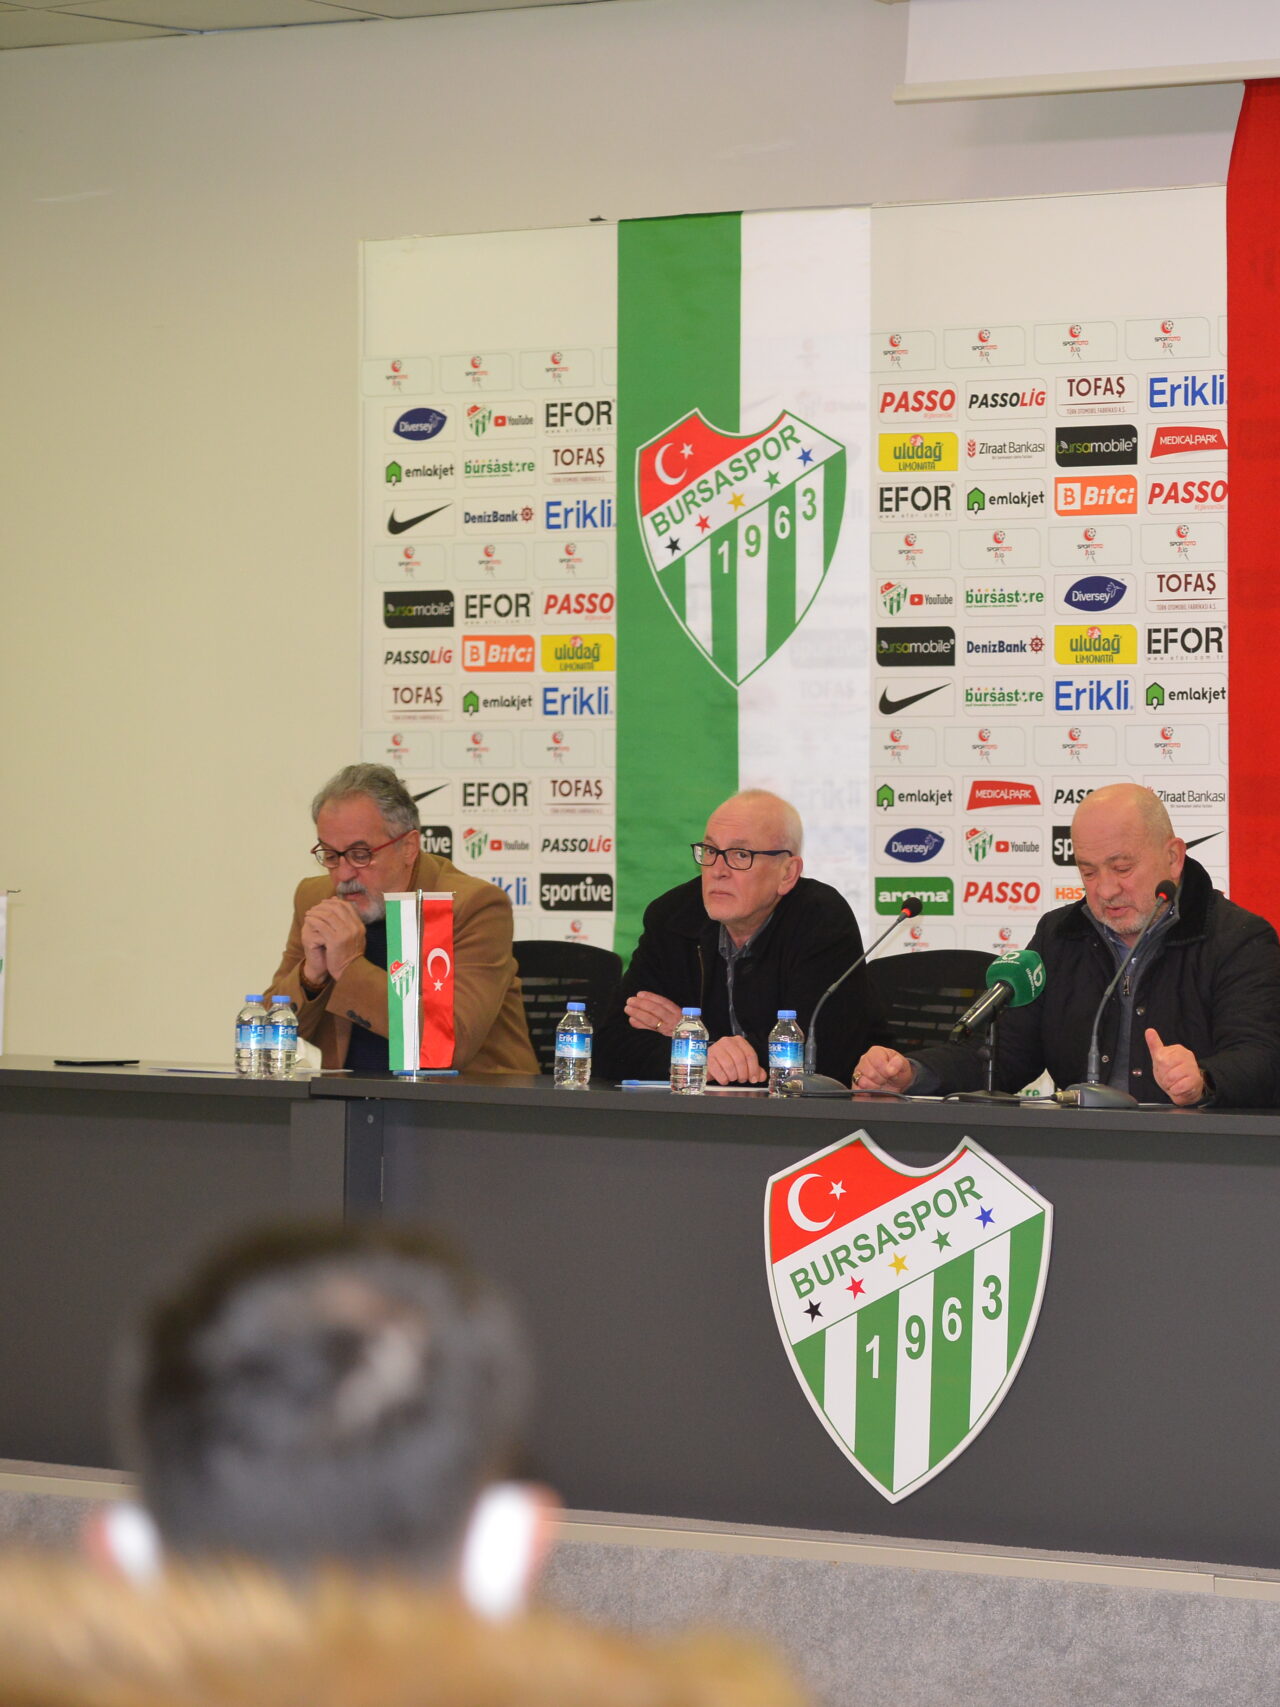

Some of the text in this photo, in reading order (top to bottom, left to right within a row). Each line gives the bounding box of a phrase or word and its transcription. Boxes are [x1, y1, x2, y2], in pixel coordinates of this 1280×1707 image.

[1067, 377, 1125, 398] TOFAŞ
[1149, 374, 1225, 408] Erikli
[880, 389, 956, 413] PASSO
[507, 415, 534, 426] YouTube
[545, 401, 613, 427] EFOR
[399, 415, 434, 434] Diversey
[553, 448, 605, 468] TOFAŞ
[893, 442, 942, 461] uludağ
[979, 442, 1045, 454] Ziraat Bankası
[405, 465, 454, 479] emlakjet
[650, 425, 801, 537] BURSASPOR
[879, 485, 951, 512] EFOR
[989, 491, 1045, 508] emlakjet
[1083, 485, 1135, 506] Bitci
[1148, 480, 1228, 504] PASSO
[464, 511, 519, 524] DenizBank
[545, 499, 612, 529] Erikli
[1157, 572, 1216, 595] TOFAŞ
[465, 594, 531, 619] EFOR
[543, 592, 615, 615] PASSO
[925, 594, 953, 605] YouTube
[1072, 591, 1111, 603] Diversey
[966, 640, 1027, 653] DenizBank
[1069, 634, 1121, 654] uludağ
[1148, 627, 1223, 654] EFOR
[488, 644, 532, 663] Bitci
[554, 643, 601, 662] uludağ
[393, 686, 443, 706] TOFAŞ
[482, 695, 533, 709] emlakjet
[542, 686, 609, 716] Erikli
[1055, 680, 1129, 711] Erikli
[1168, 687, 1226, 704] emlakjet
[462, 782, 528, 807] EFOR
[551, 780, 603, 799] TOFAŞ
[898, 790, 952, 806] emlakjet
[1188, 790, 1225, 802] Bankası
[421, 829, 450, 849] tive
[503, 839, 530, 850] YouTube
[891, 842, 929, 855] Diversey
[1010, 842, 1040, 851] YouTube
[541, 876, 612, 907] sportive
[878, 891, 949, 903] aroma
[963, 882, 1041, 903] PASSO
[789, 1175, 984, 1300] BURSASPOR
